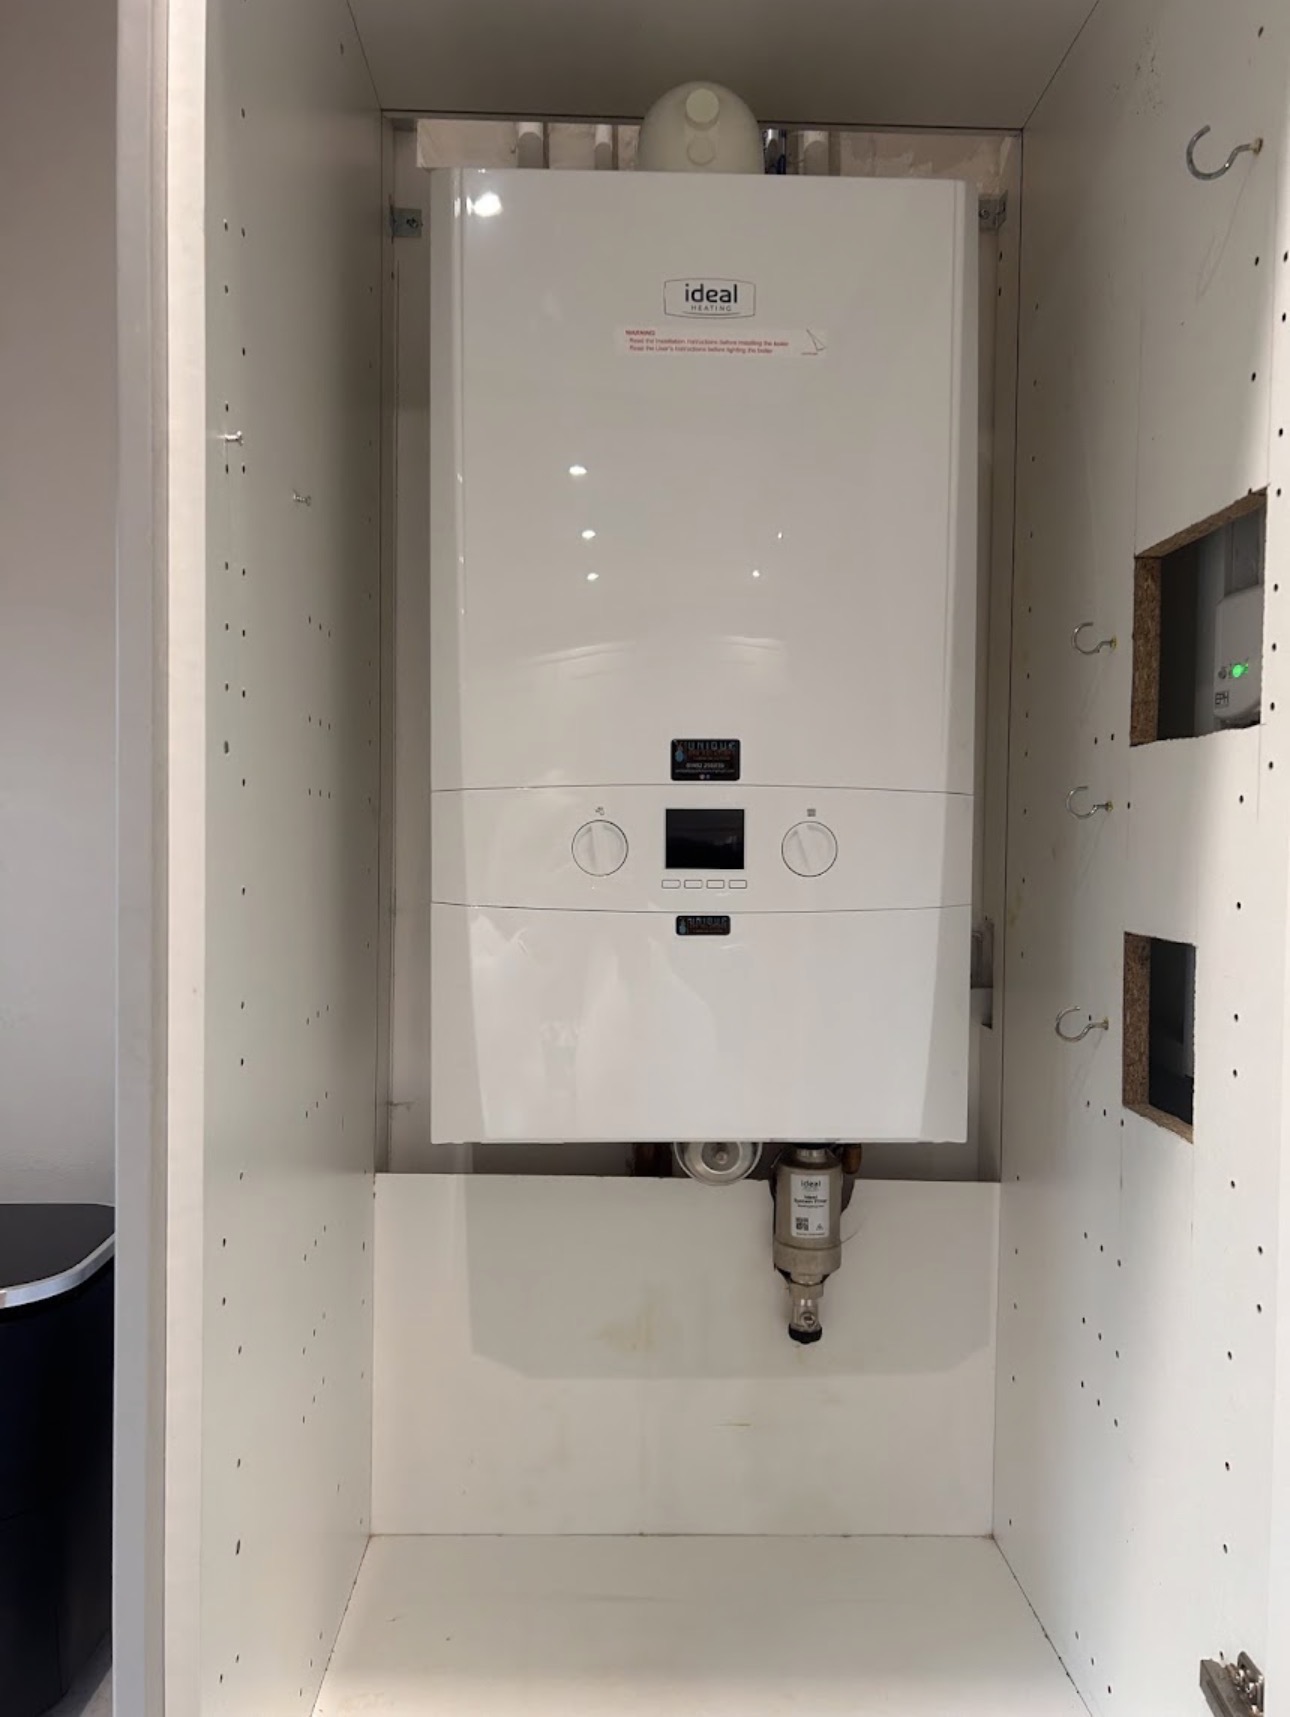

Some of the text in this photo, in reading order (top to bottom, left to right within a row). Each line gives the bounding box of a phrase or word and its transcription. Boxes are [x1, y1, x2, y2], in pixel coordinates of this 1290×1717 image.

[685, 283, 737, 303] ideal
[691, 304, 732, 312] HEATING
[1215, 691, 1229, 705] EPH
